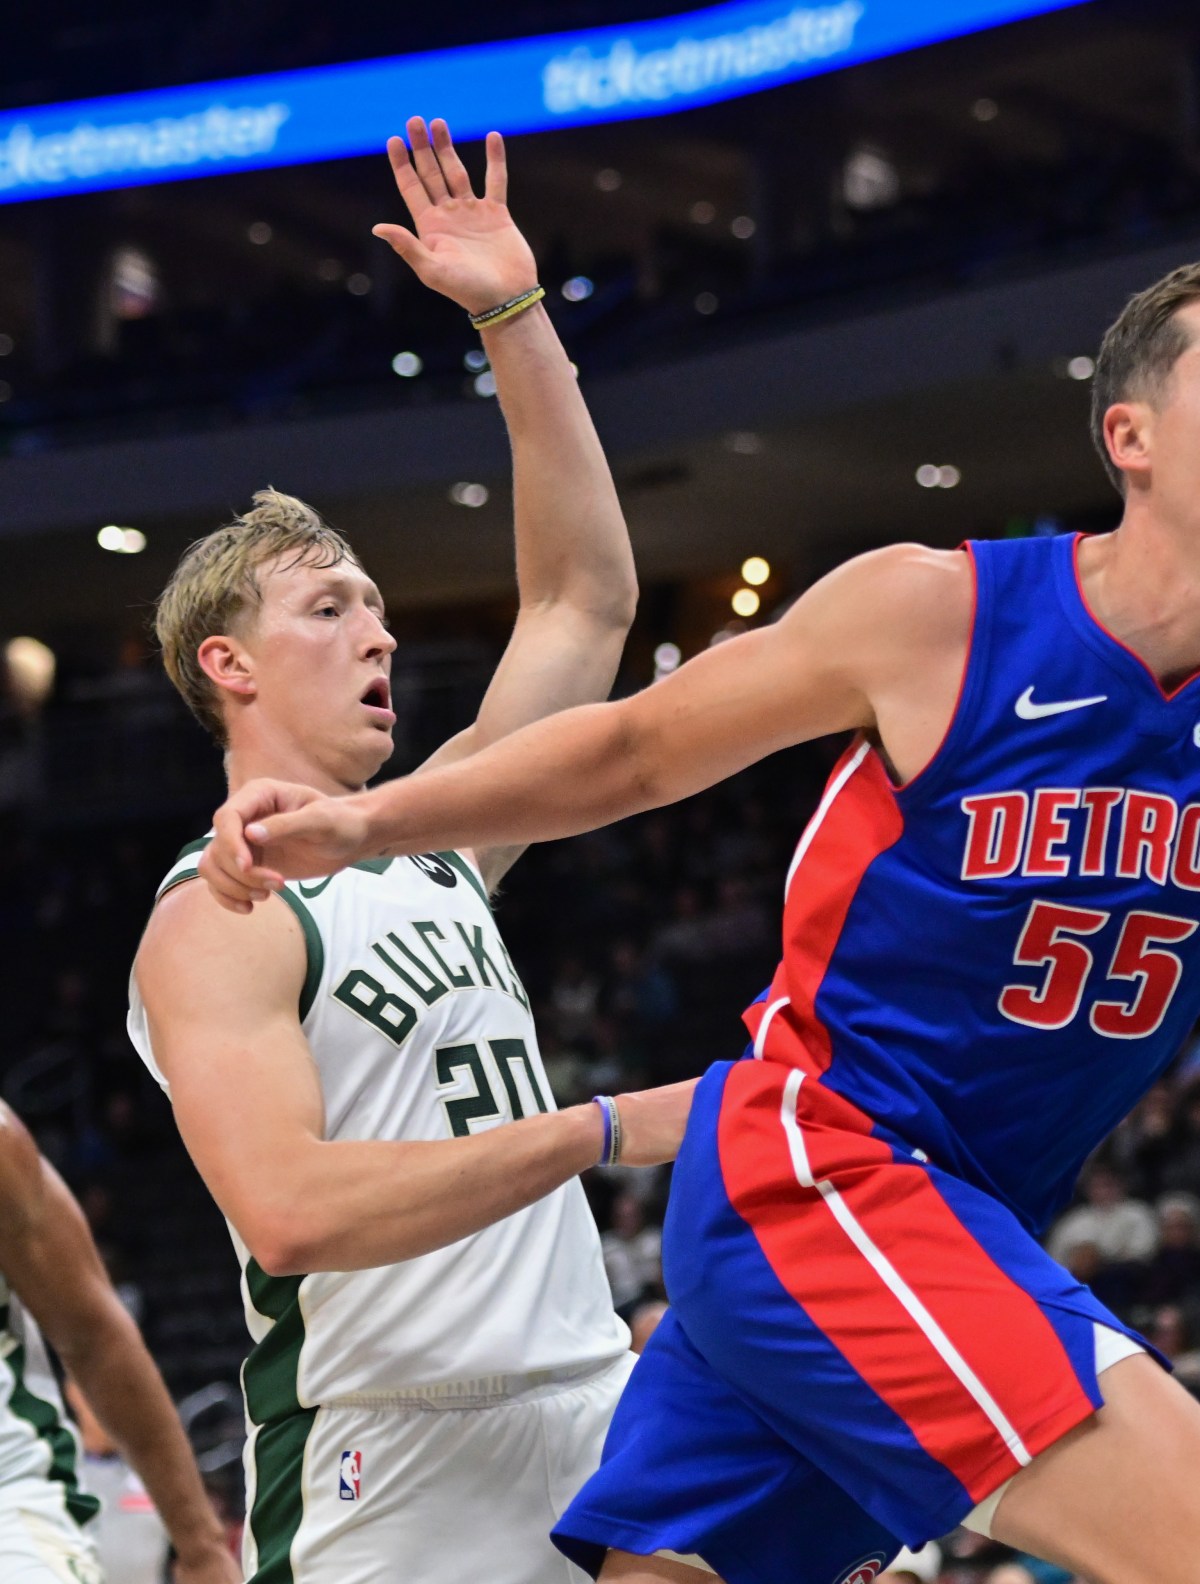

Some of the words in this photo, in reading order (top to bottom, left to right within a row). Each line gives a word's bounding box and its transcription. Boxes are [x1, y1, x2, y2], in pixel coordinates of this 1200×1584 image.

[543, 2, 863, 113] ticketmaster
[998, 899, 1200, 1040] 55
[434, 1037, 550, 1139] 20
